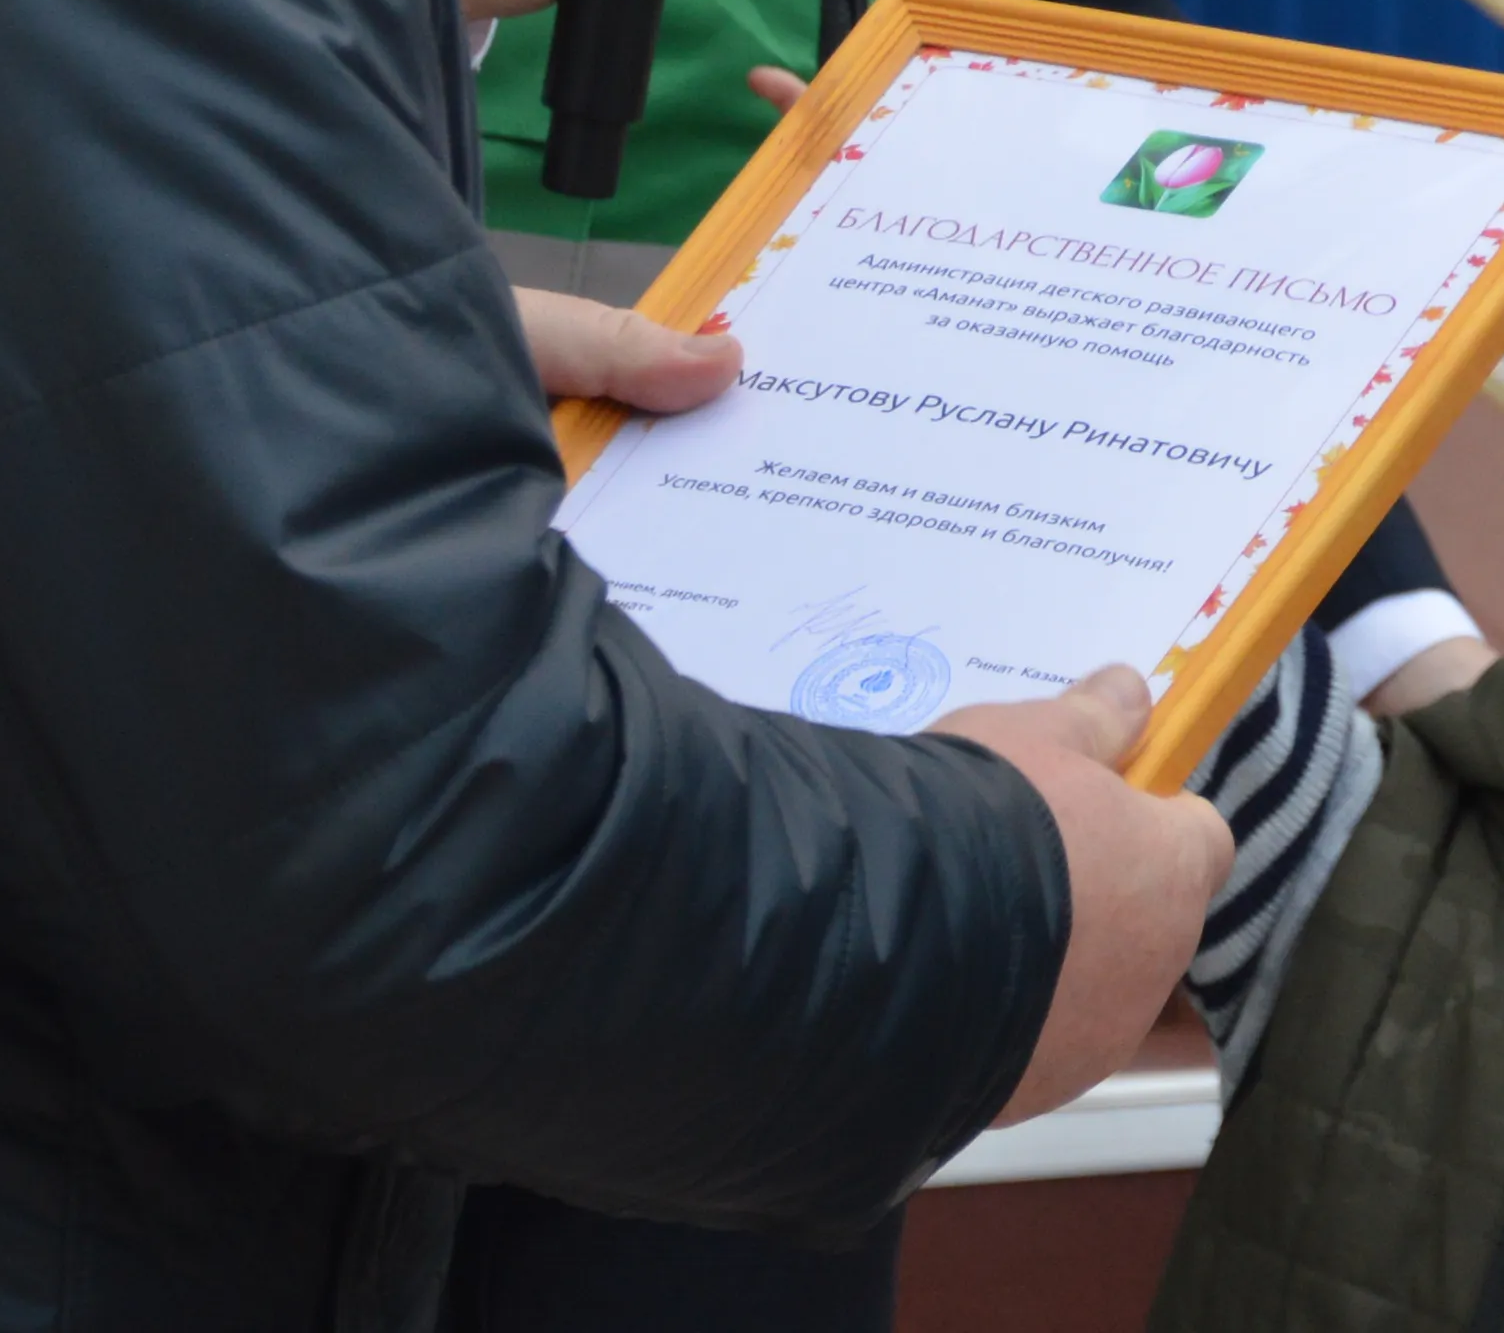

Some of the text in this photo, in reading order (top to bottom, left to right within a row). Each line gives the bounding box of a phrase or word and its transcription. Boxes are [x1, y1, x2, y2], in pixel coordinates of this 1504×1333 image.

[836, 207, 1397, 316] БЛАГОДАРСТВЕННОЕ ПИСЬМО
[857, 253, 1316, 341] Администрация детского развивающего
[828, 274, 1311, 367] центра «Аманат» выражает благодарность
[924, 313, 1176, 368] за оказанную помощь
[737, 369, 1274, 481] Максутову Руслану Ринатовичу
[657, 473, 1175, 574] Успехов, крепкого здоровья и благополучия!
[754, 459, 1107, 535] Желаем вам и вашим близким
[660, 588, 740, 610] директор
[965, 656, 1078, 686] Ринат Казакк
